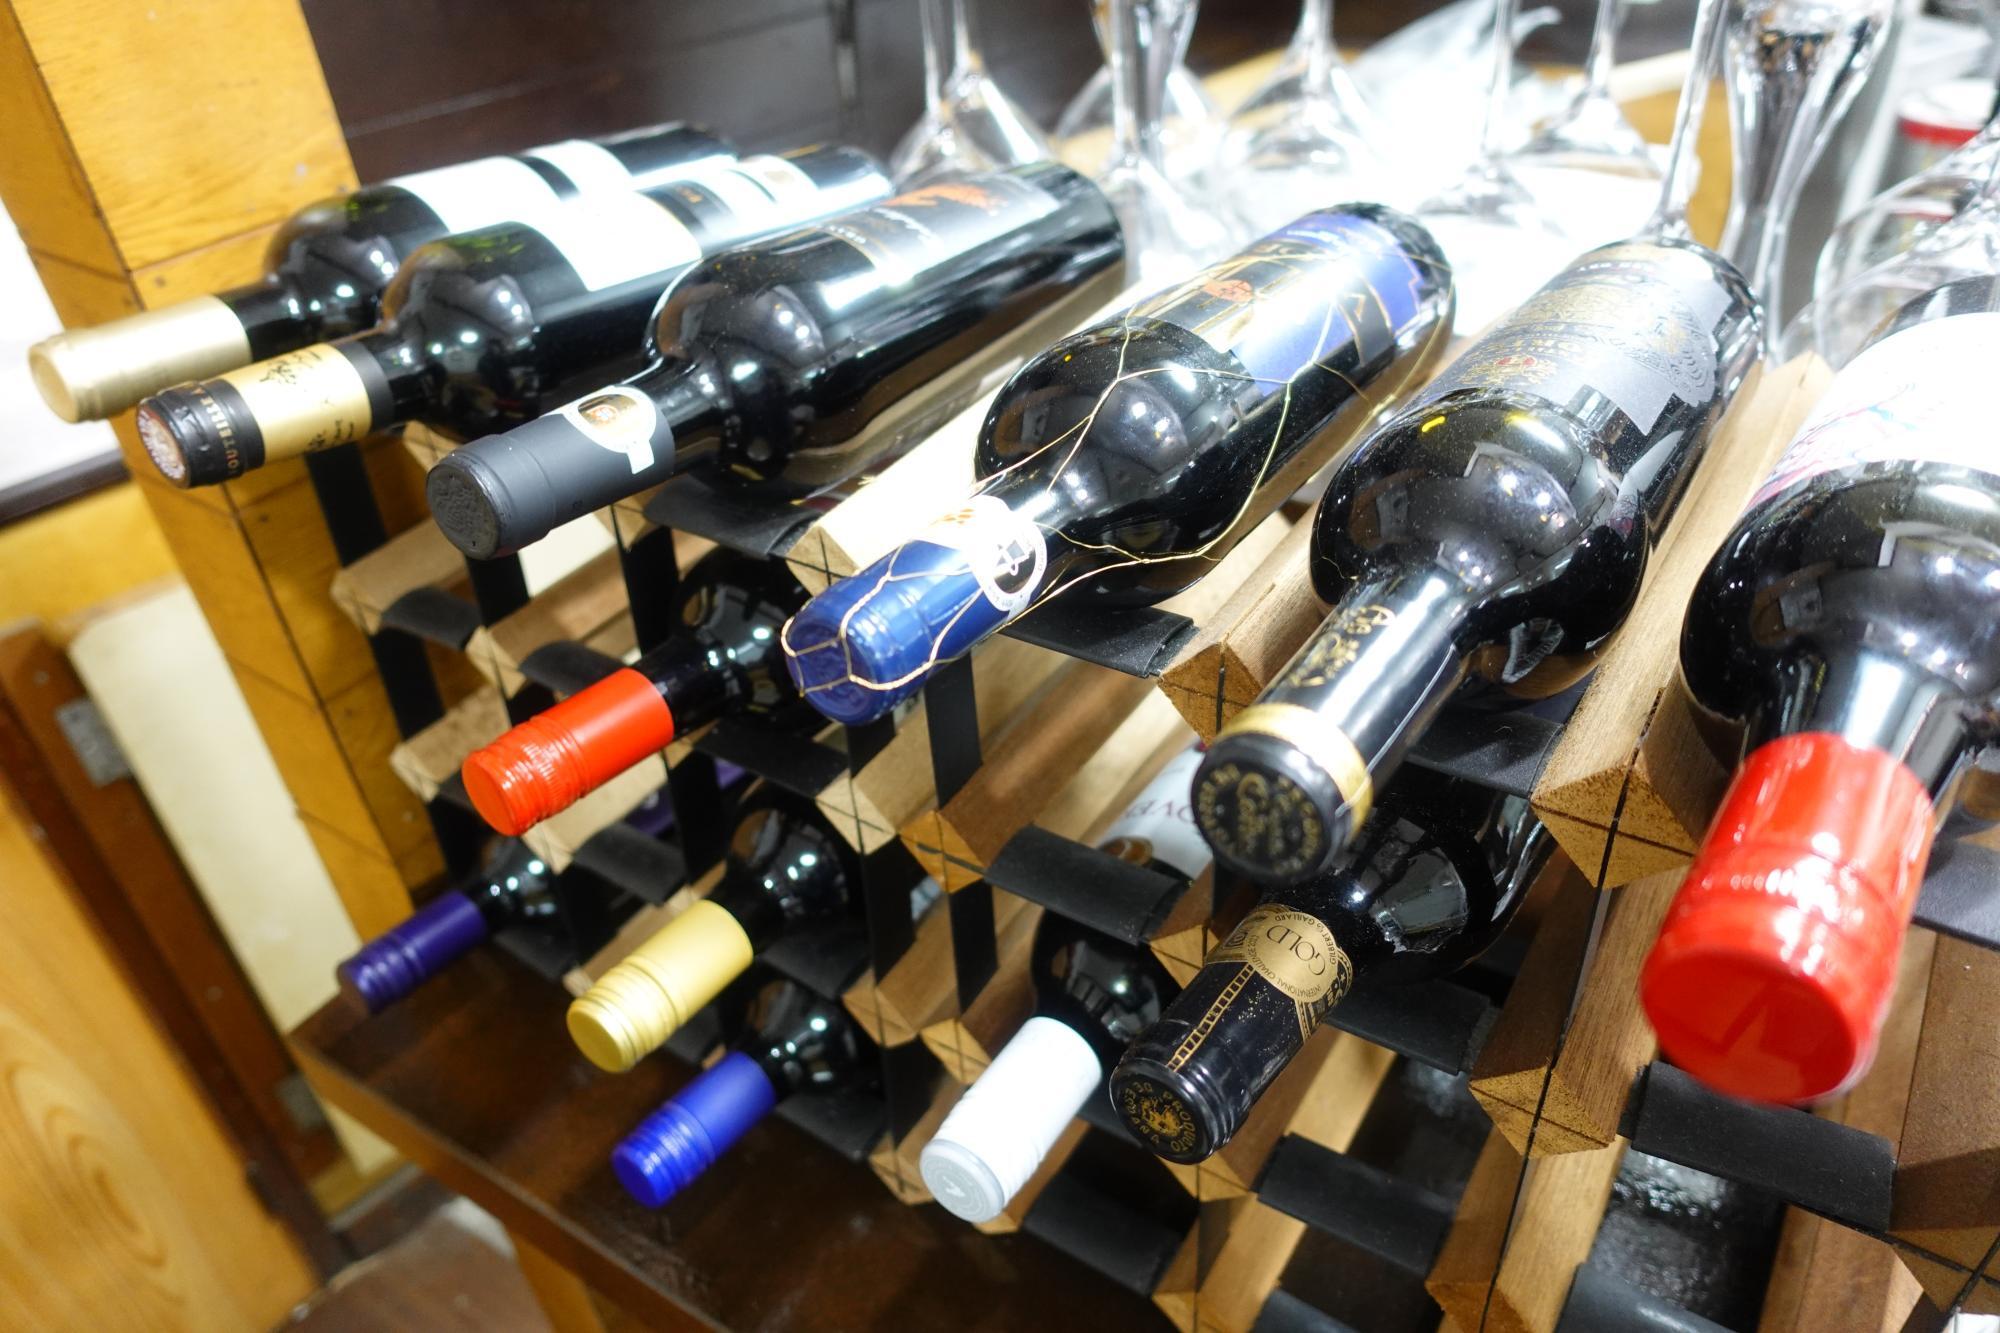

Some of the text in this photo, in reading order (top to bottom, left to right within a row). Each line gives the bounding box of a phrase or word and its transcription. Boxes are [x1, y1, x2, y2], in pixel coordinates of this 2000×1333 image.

[201, 396, 239, 474] OUTEILLE
[1274, 912, 1316, 926] GAILLARD
[1265, 924, 1326, 976] GOLD
[1322, 932, 1337, 965] GILBERT
